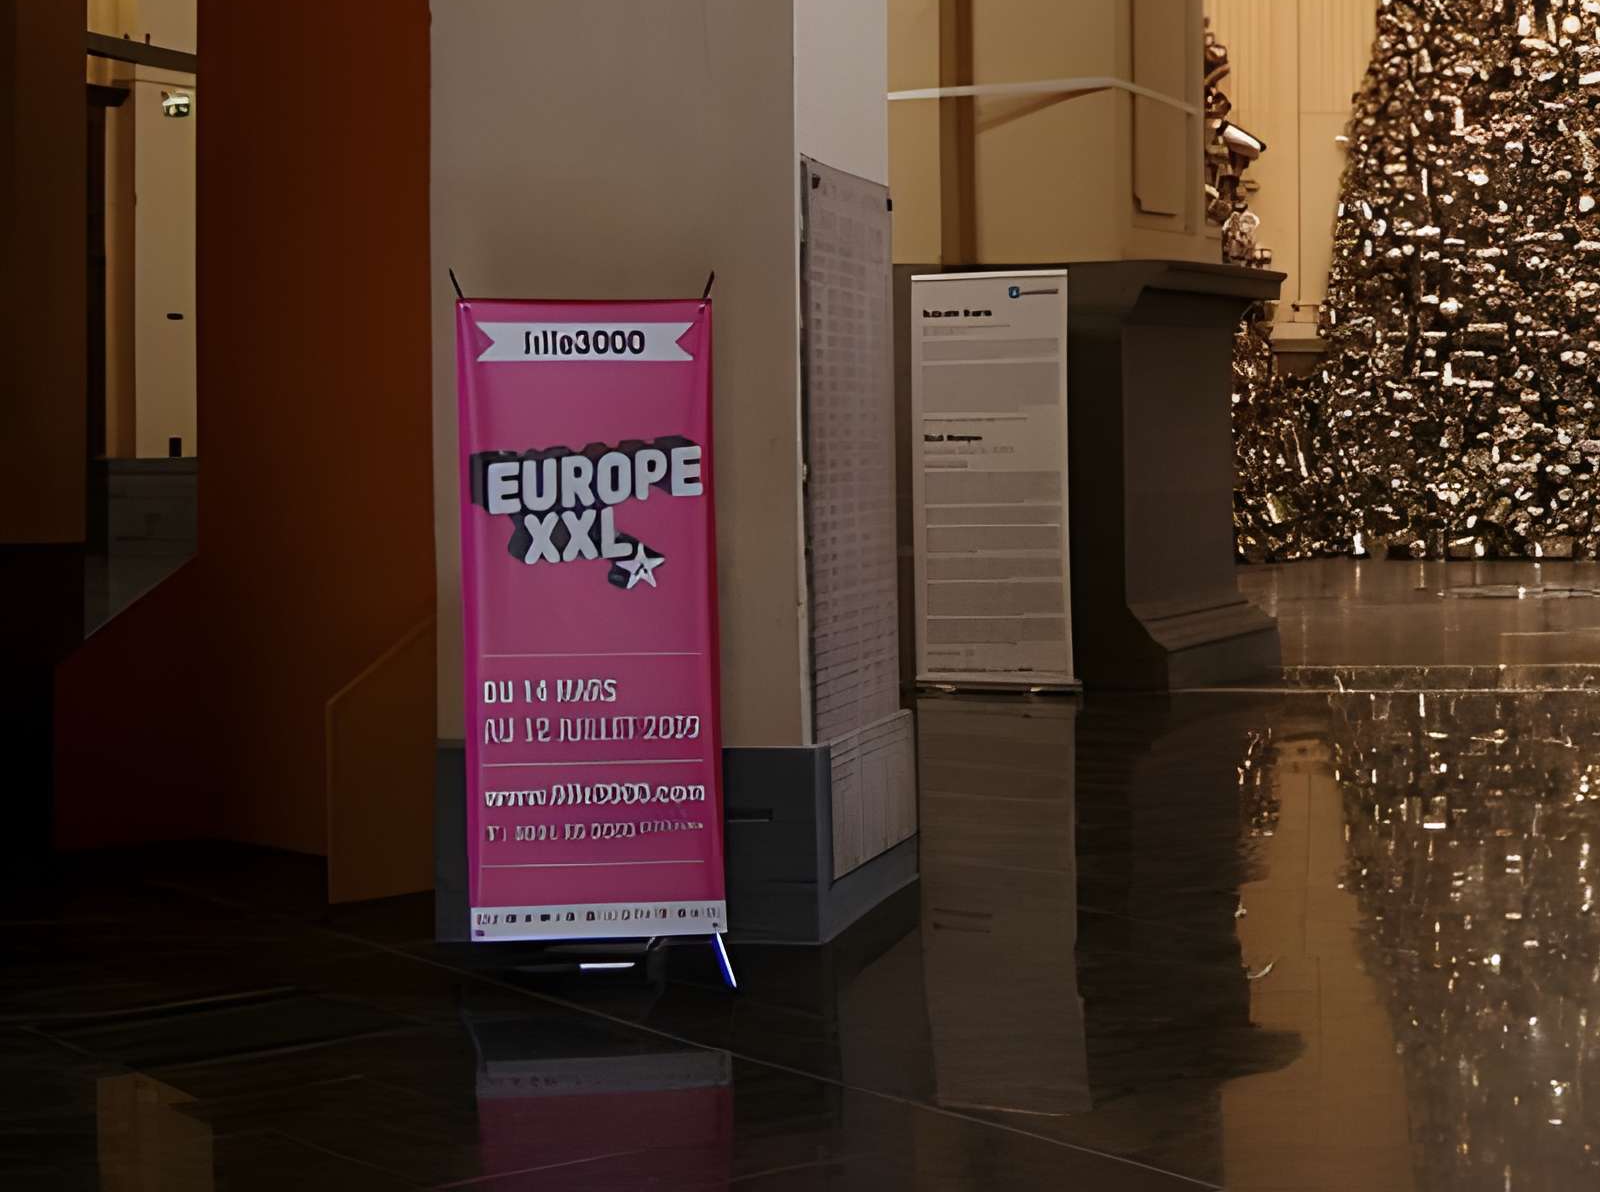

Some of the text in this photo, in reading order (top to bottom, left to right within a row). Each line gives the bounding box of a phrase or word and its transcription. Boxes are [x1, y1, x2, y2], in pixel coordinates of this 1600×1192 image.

[524, 330, 646, 356] lille3000
[486, 445, 704, 515] EUROPE
[523, 506, 633, 566] XXL
[484, 680, 514, 704] DU
